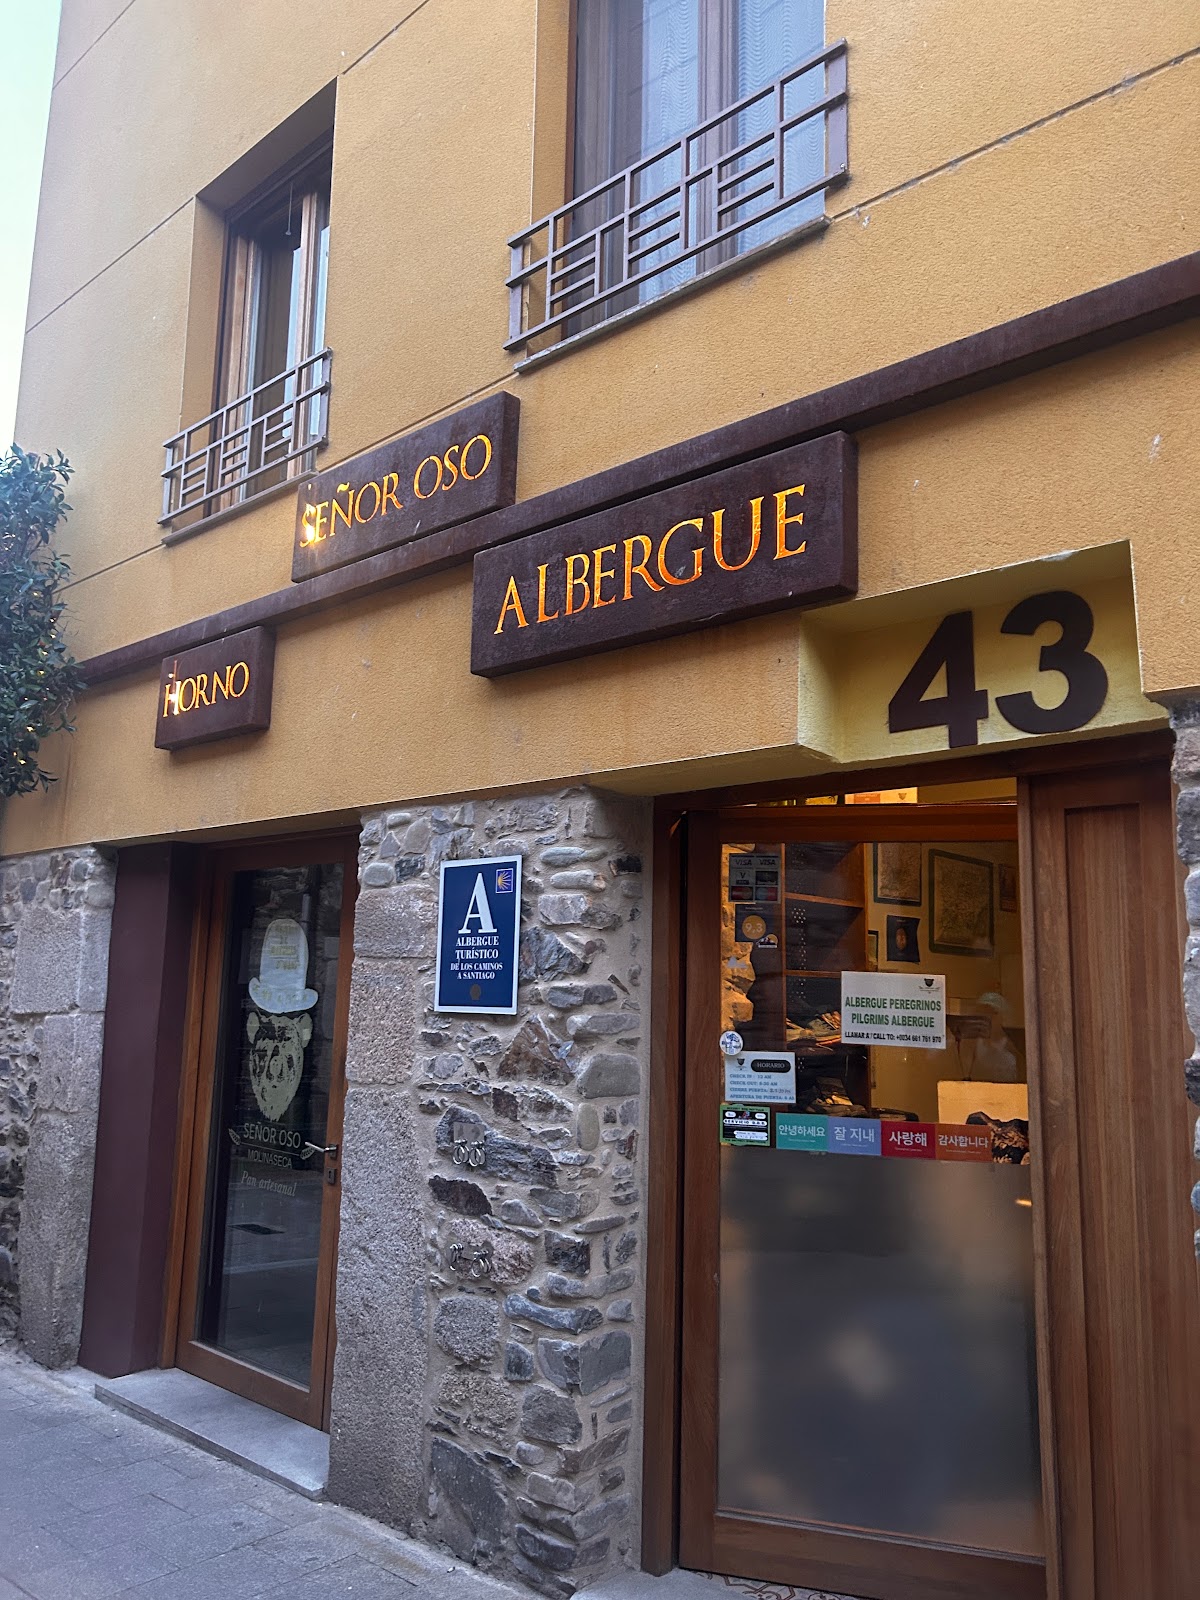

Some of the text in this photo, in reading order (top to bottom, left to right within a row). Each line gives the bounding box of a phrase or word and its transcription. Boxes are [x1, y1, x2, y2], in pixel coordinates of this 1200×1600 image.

[300, 434, 492, 547] SEÑOR OSO
[494, 484, 806, 634] ALBERGUE
[888, 590, 1108, 748] 43
[162, 662, 250, 718] HORNO
[458, 873, 497, 934] A
[746, 922, 763, 933] 9,3
[456, 936, 499, 946] ALBERGUE
[455, 947, 498, 960] TURÍSTICO
[450, 962, 502, 971] DE LOS CAMINOS
[463, 971, 495, 979] SANTIAGO
[845, 997, 941, 1011] ALBERGUE PEREGRINOS
[852, 1013, 934, 1027] PILGRIMS ALBERGUE
[243, 1122, 301, 1148] SEÑOR OSO
[779, 1124, 825, 1137] 안녕하세요
[834, 1127, 875, 1142] 잘 지내
[889, 1131, 927, 1146] 사랑해
[938, 1135, 989, 1148] 감사합니다
[248, 1149, 292, 1169] MOLINASECA
[241, 1171, 297, 1196] Pan artesanal
